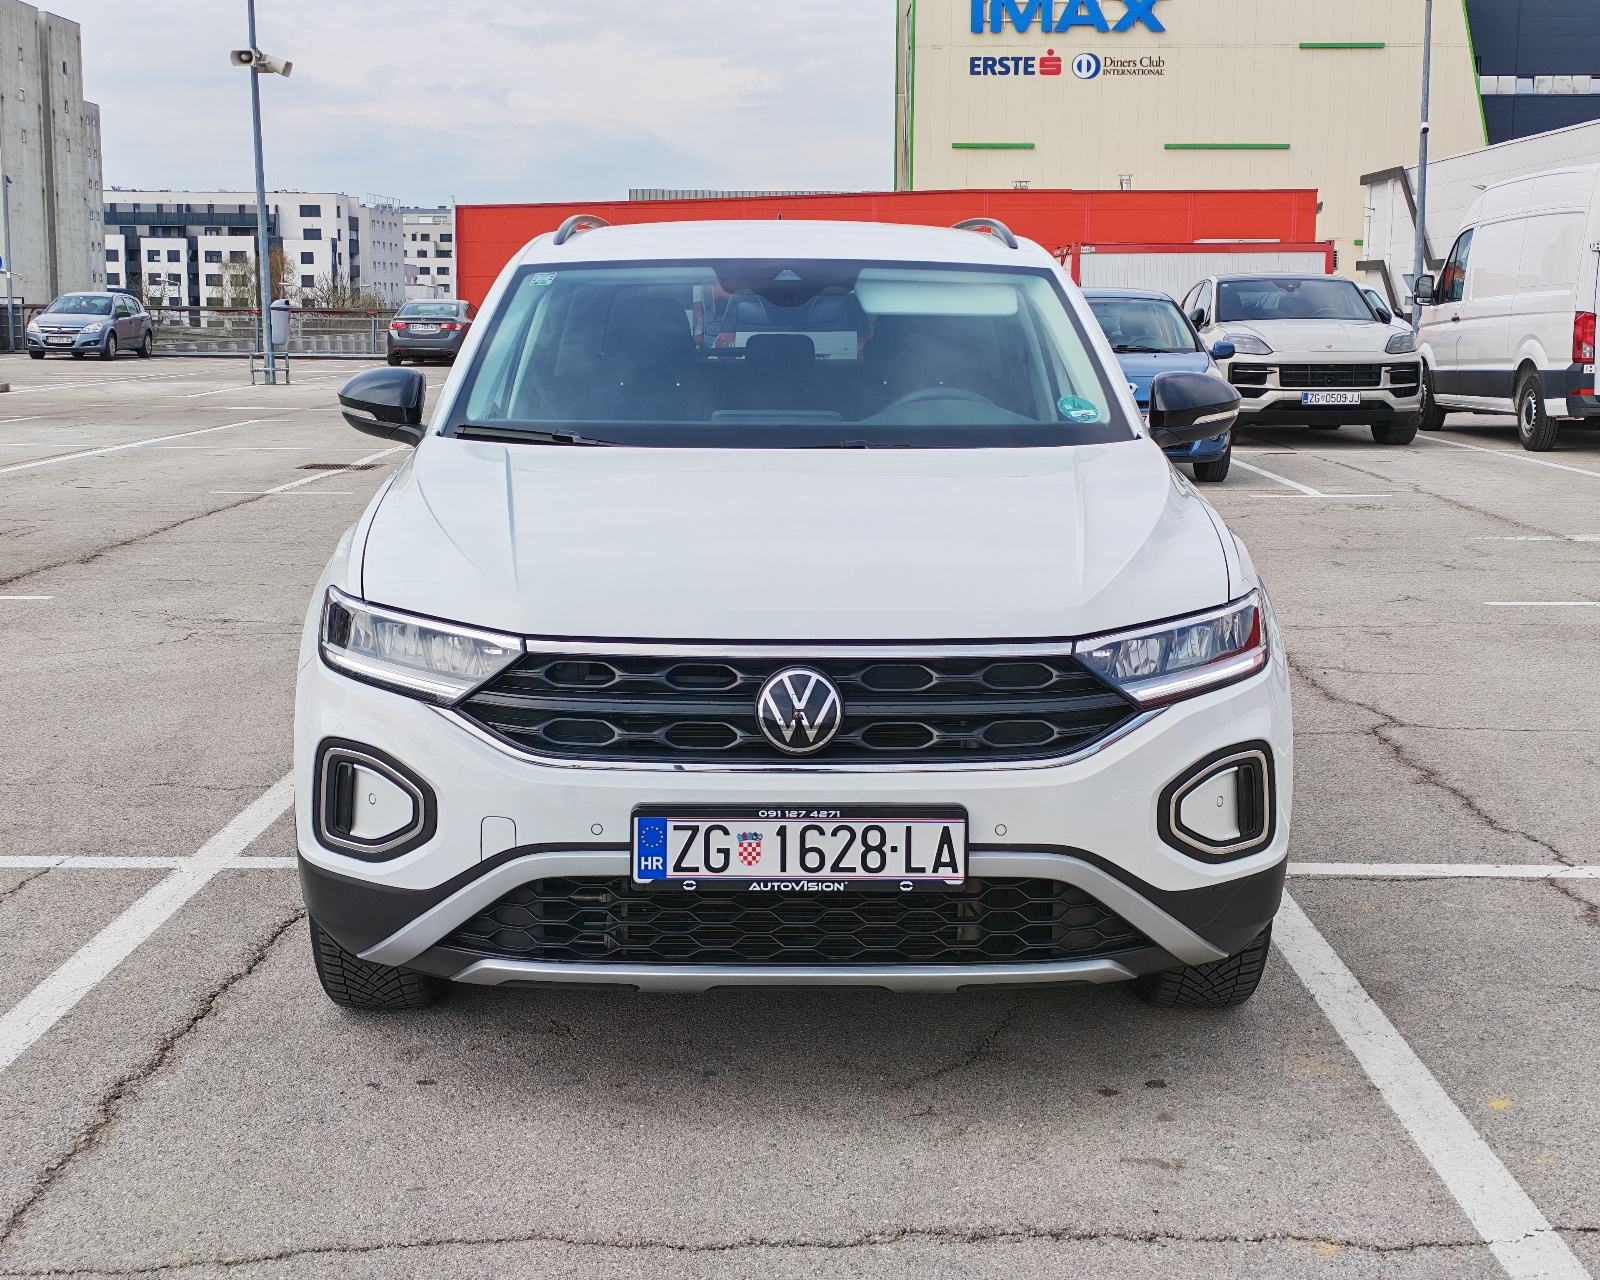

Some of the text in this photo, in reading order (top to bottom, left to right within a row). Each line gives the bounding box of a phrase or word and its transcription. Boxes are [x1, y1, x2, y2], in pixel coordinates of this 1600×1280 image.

[971, 0, 1166, 33] IMAX
[969, 56, 1036, 76] ERSTE
[1103, 56, 1165, 68] Diners Club
[758, 810, 840, 818] 091 127 4271
[640, 856, 663, 870] HR
[672, 824, 731, 873] ZG
